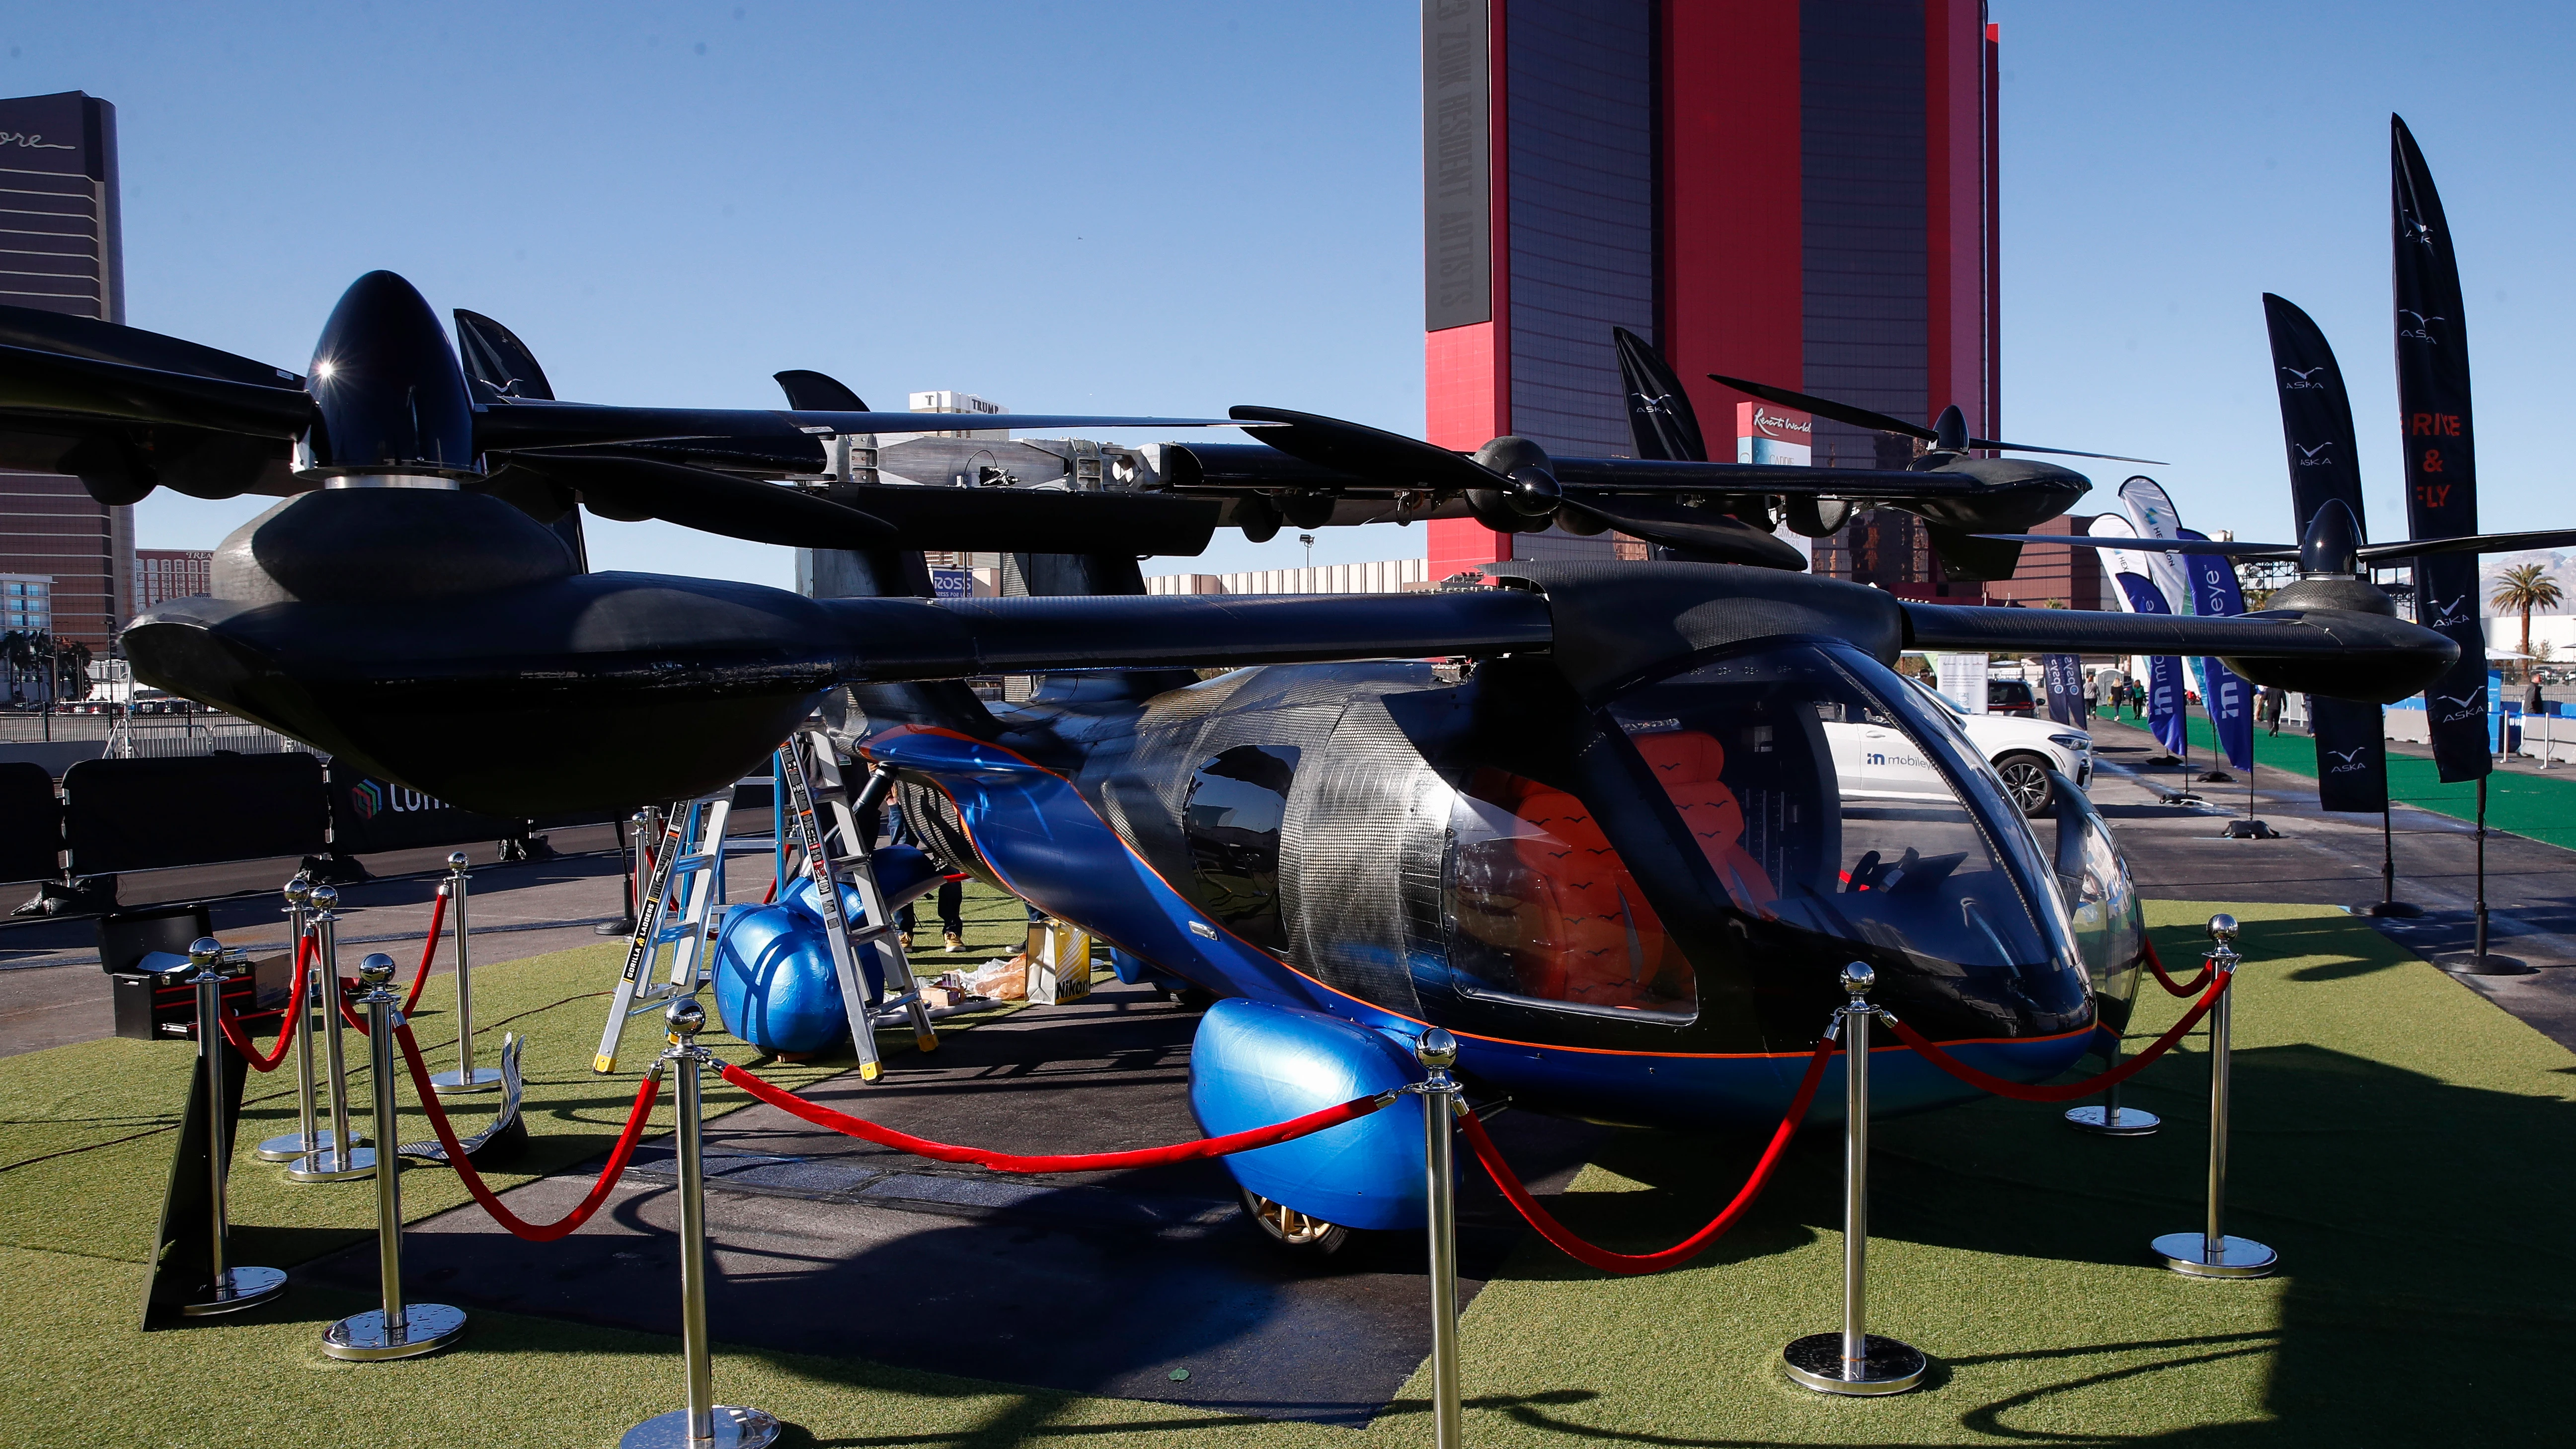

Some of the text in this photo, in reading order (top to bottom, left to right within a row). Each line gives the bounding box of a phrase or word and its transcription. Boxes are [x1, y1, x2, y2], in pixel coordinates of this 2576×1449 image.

[1436, 23, 1471, 89] ZOUK
[1437, 91, 1472, 198] RESIDENT
[1439, 211, 1474, 307] ARTISTS
[925, 395, 935, 405] T
[972, 398, 999, 414] TRUMP
[1785, 418, 1811, 433] World
[2300, 458, 2332, 466] ASKA
[2423, 449, 2443, 472] &
[934, 577, 971, 590] ROSS
[2443, 705, 2484, 723] ASKA
[2331, 763, 2366, 773] ASKA
[627, 904, 654, 978] GORILLA LADDERS
[1056, 979, 1089, 1000] Nikon
